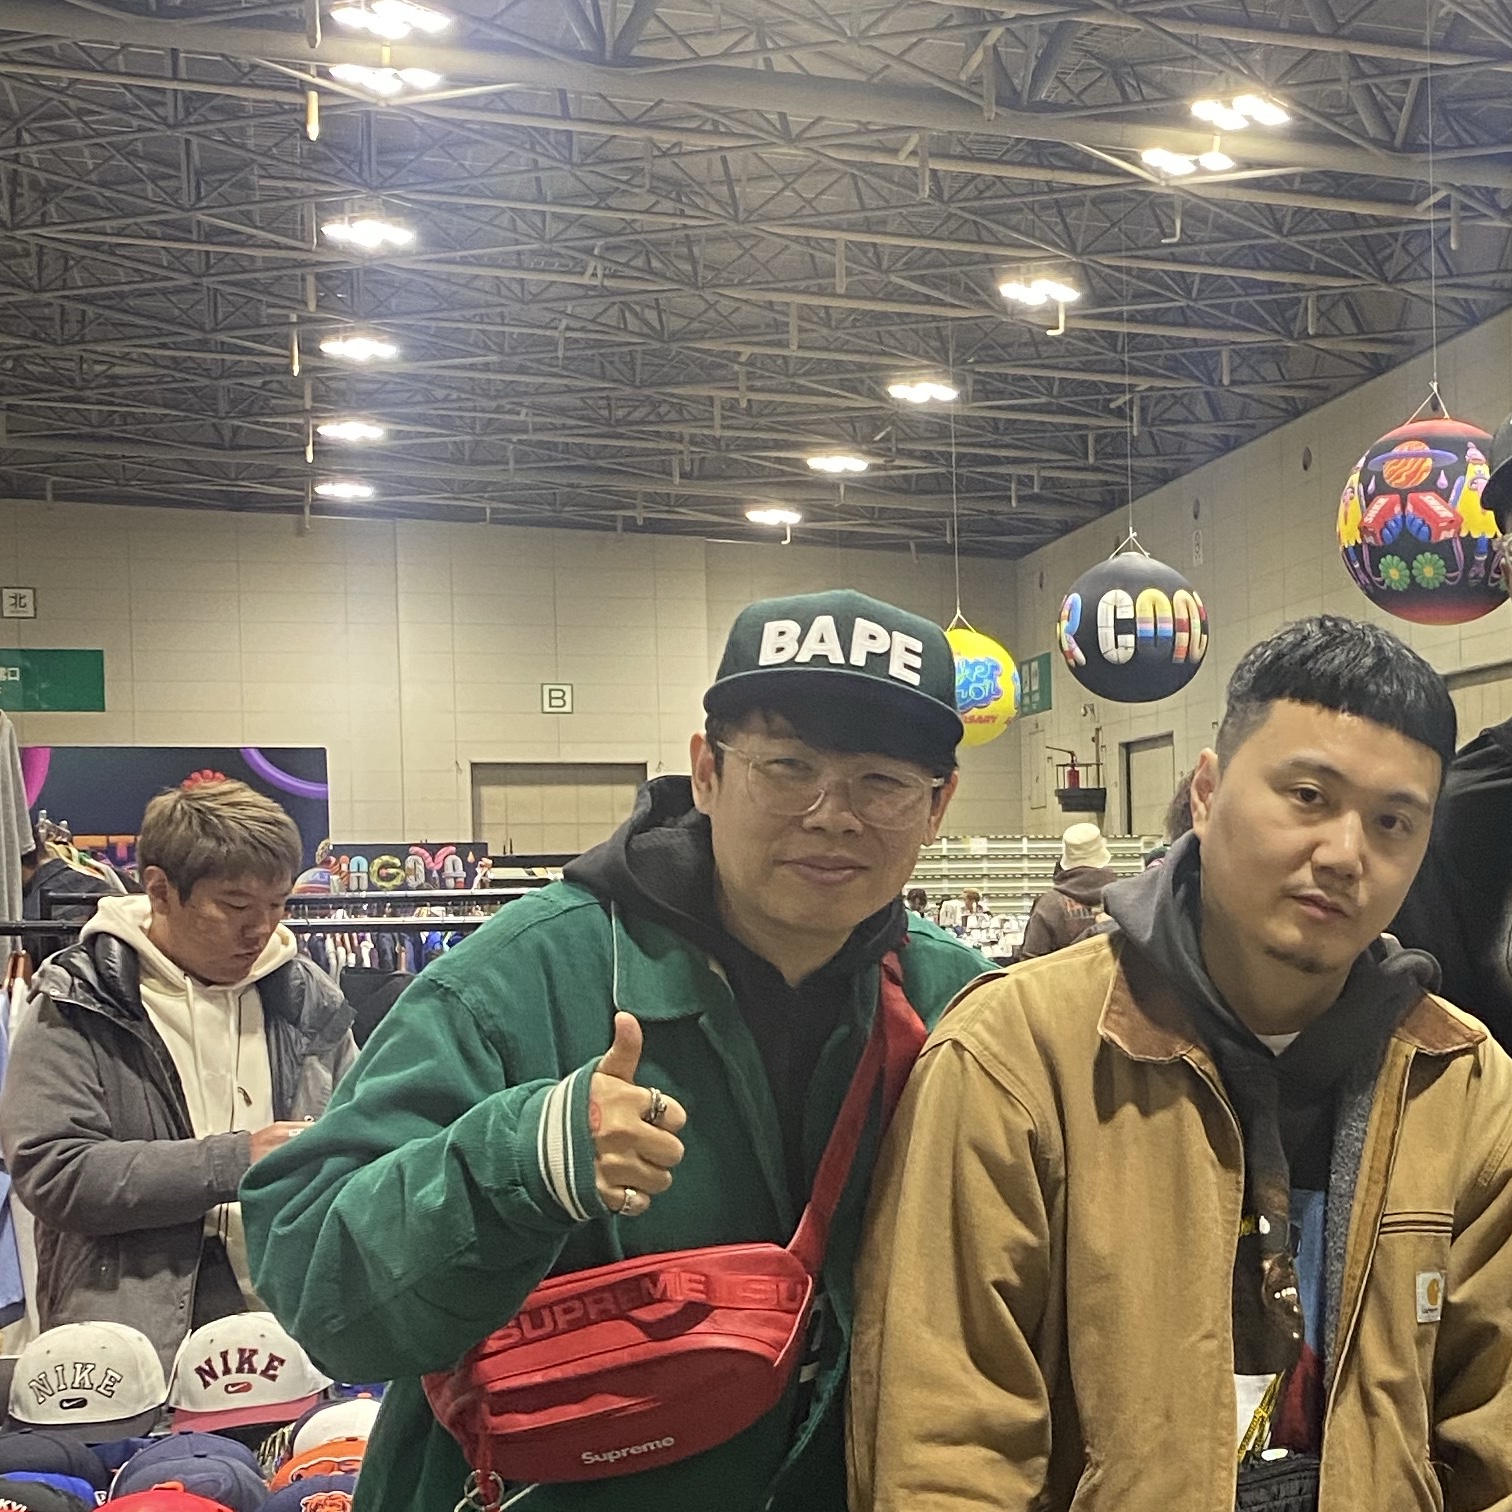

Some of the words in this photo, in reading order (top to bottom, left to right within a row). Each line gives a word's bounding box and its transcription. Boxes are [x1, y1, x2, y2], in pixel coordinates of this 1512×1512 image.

[758, 615, 923, 686] BAPE
[548, 688, 566, 709] B
[29, 1362, 122, 1404] NIKE
[194, 1347, 286, 1390] NIKE
[581, 1434, 675, 1465] Supreme
